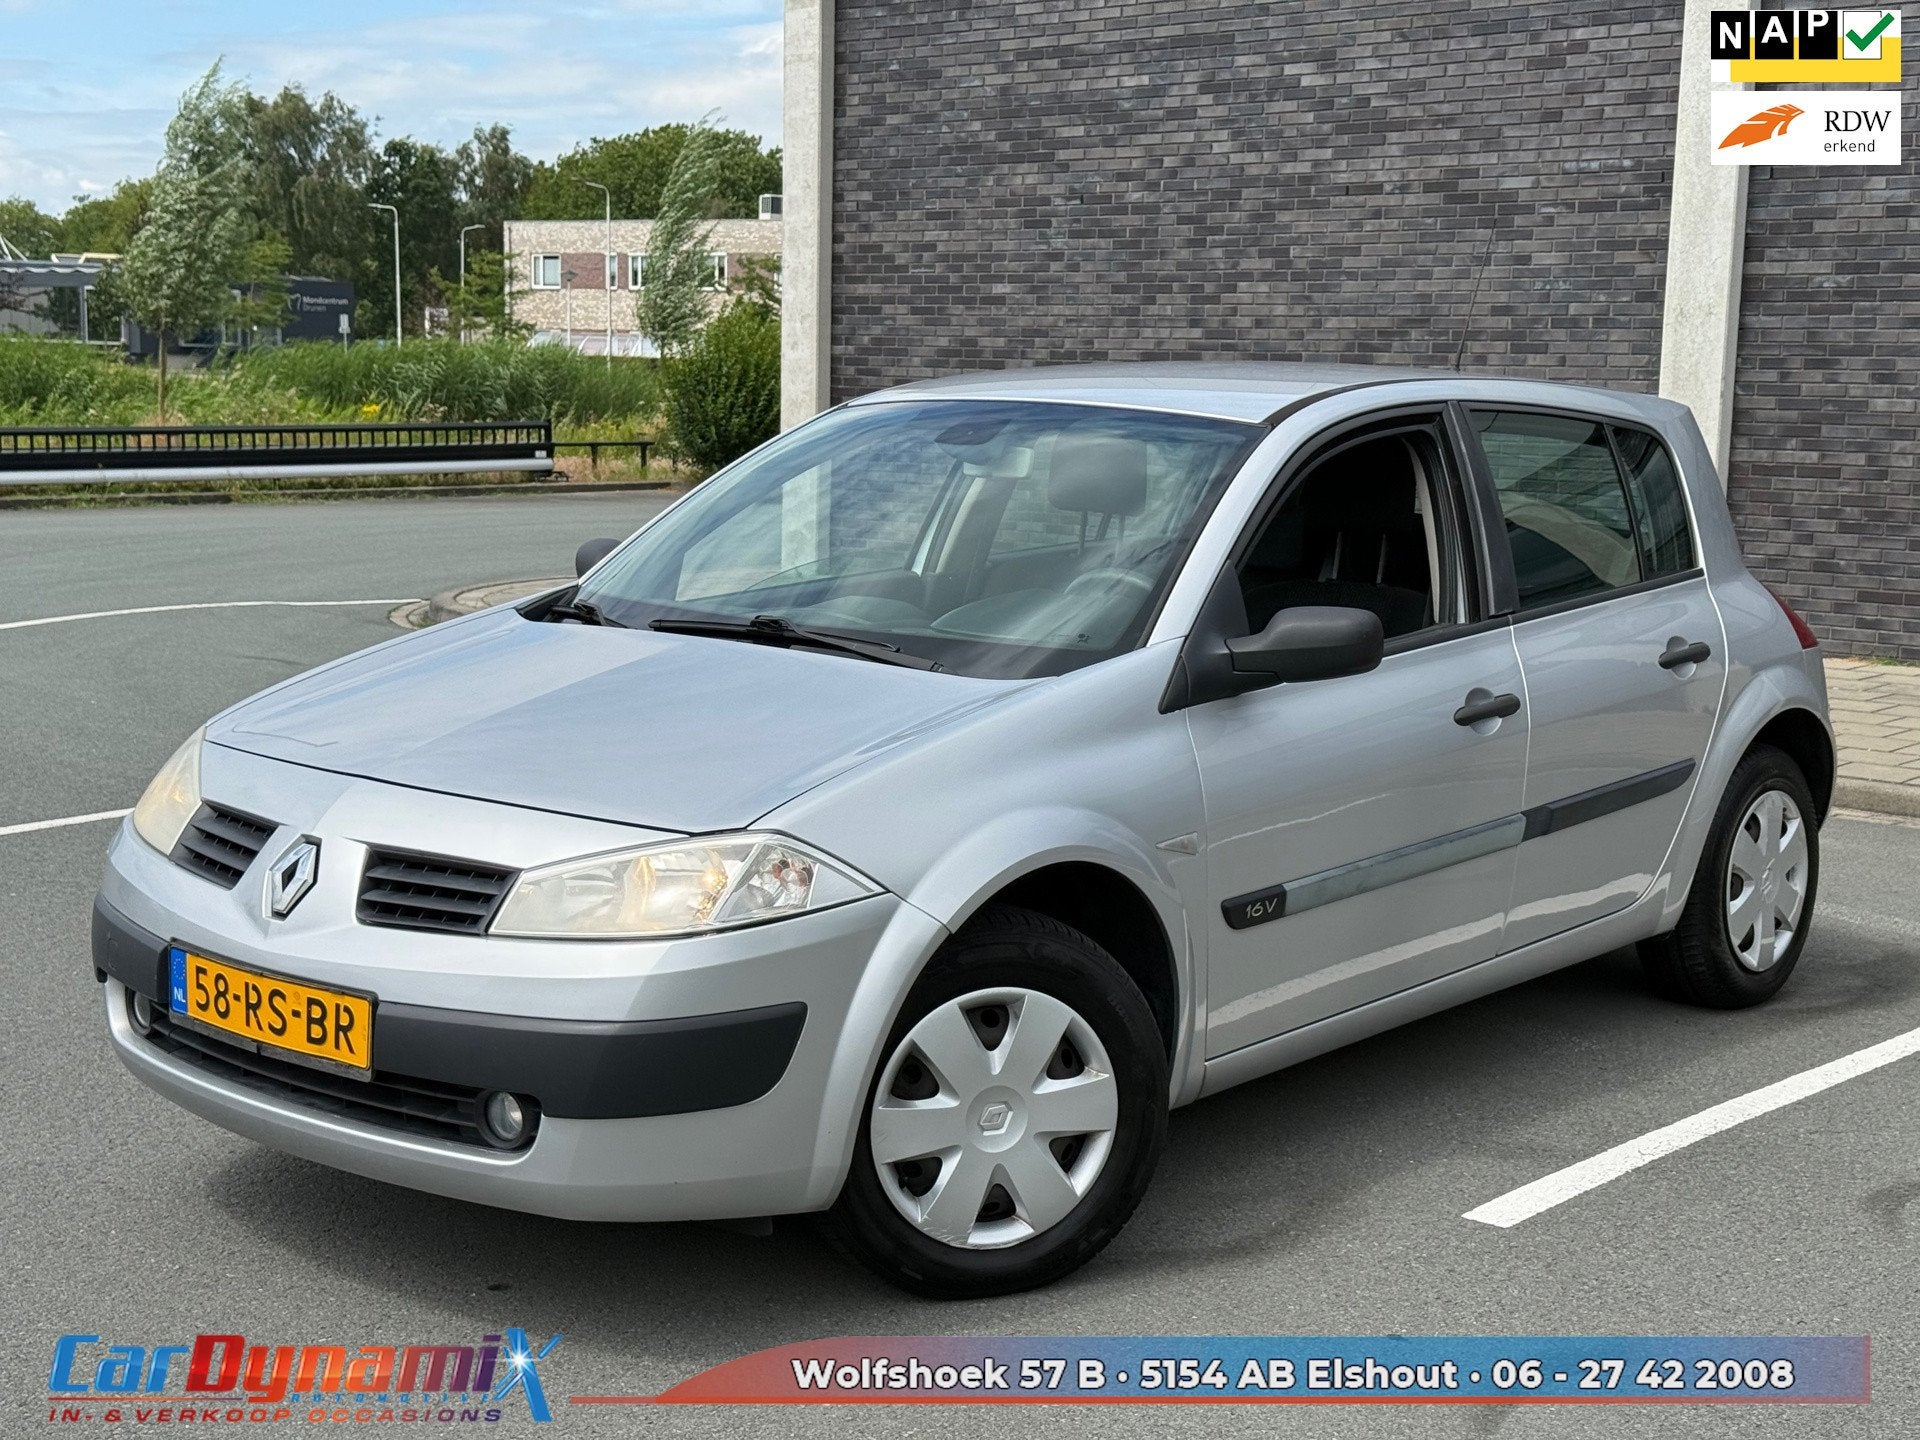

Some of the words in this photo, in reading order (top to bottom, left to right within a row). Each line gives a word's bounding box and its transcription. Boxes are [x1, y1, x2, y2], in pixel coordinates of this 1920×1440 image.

[1246, 898, 1277, 918] 16V
[173, 986, 186, 1003] NL
[195, 964, 355, 1054] 58-RS-BR
